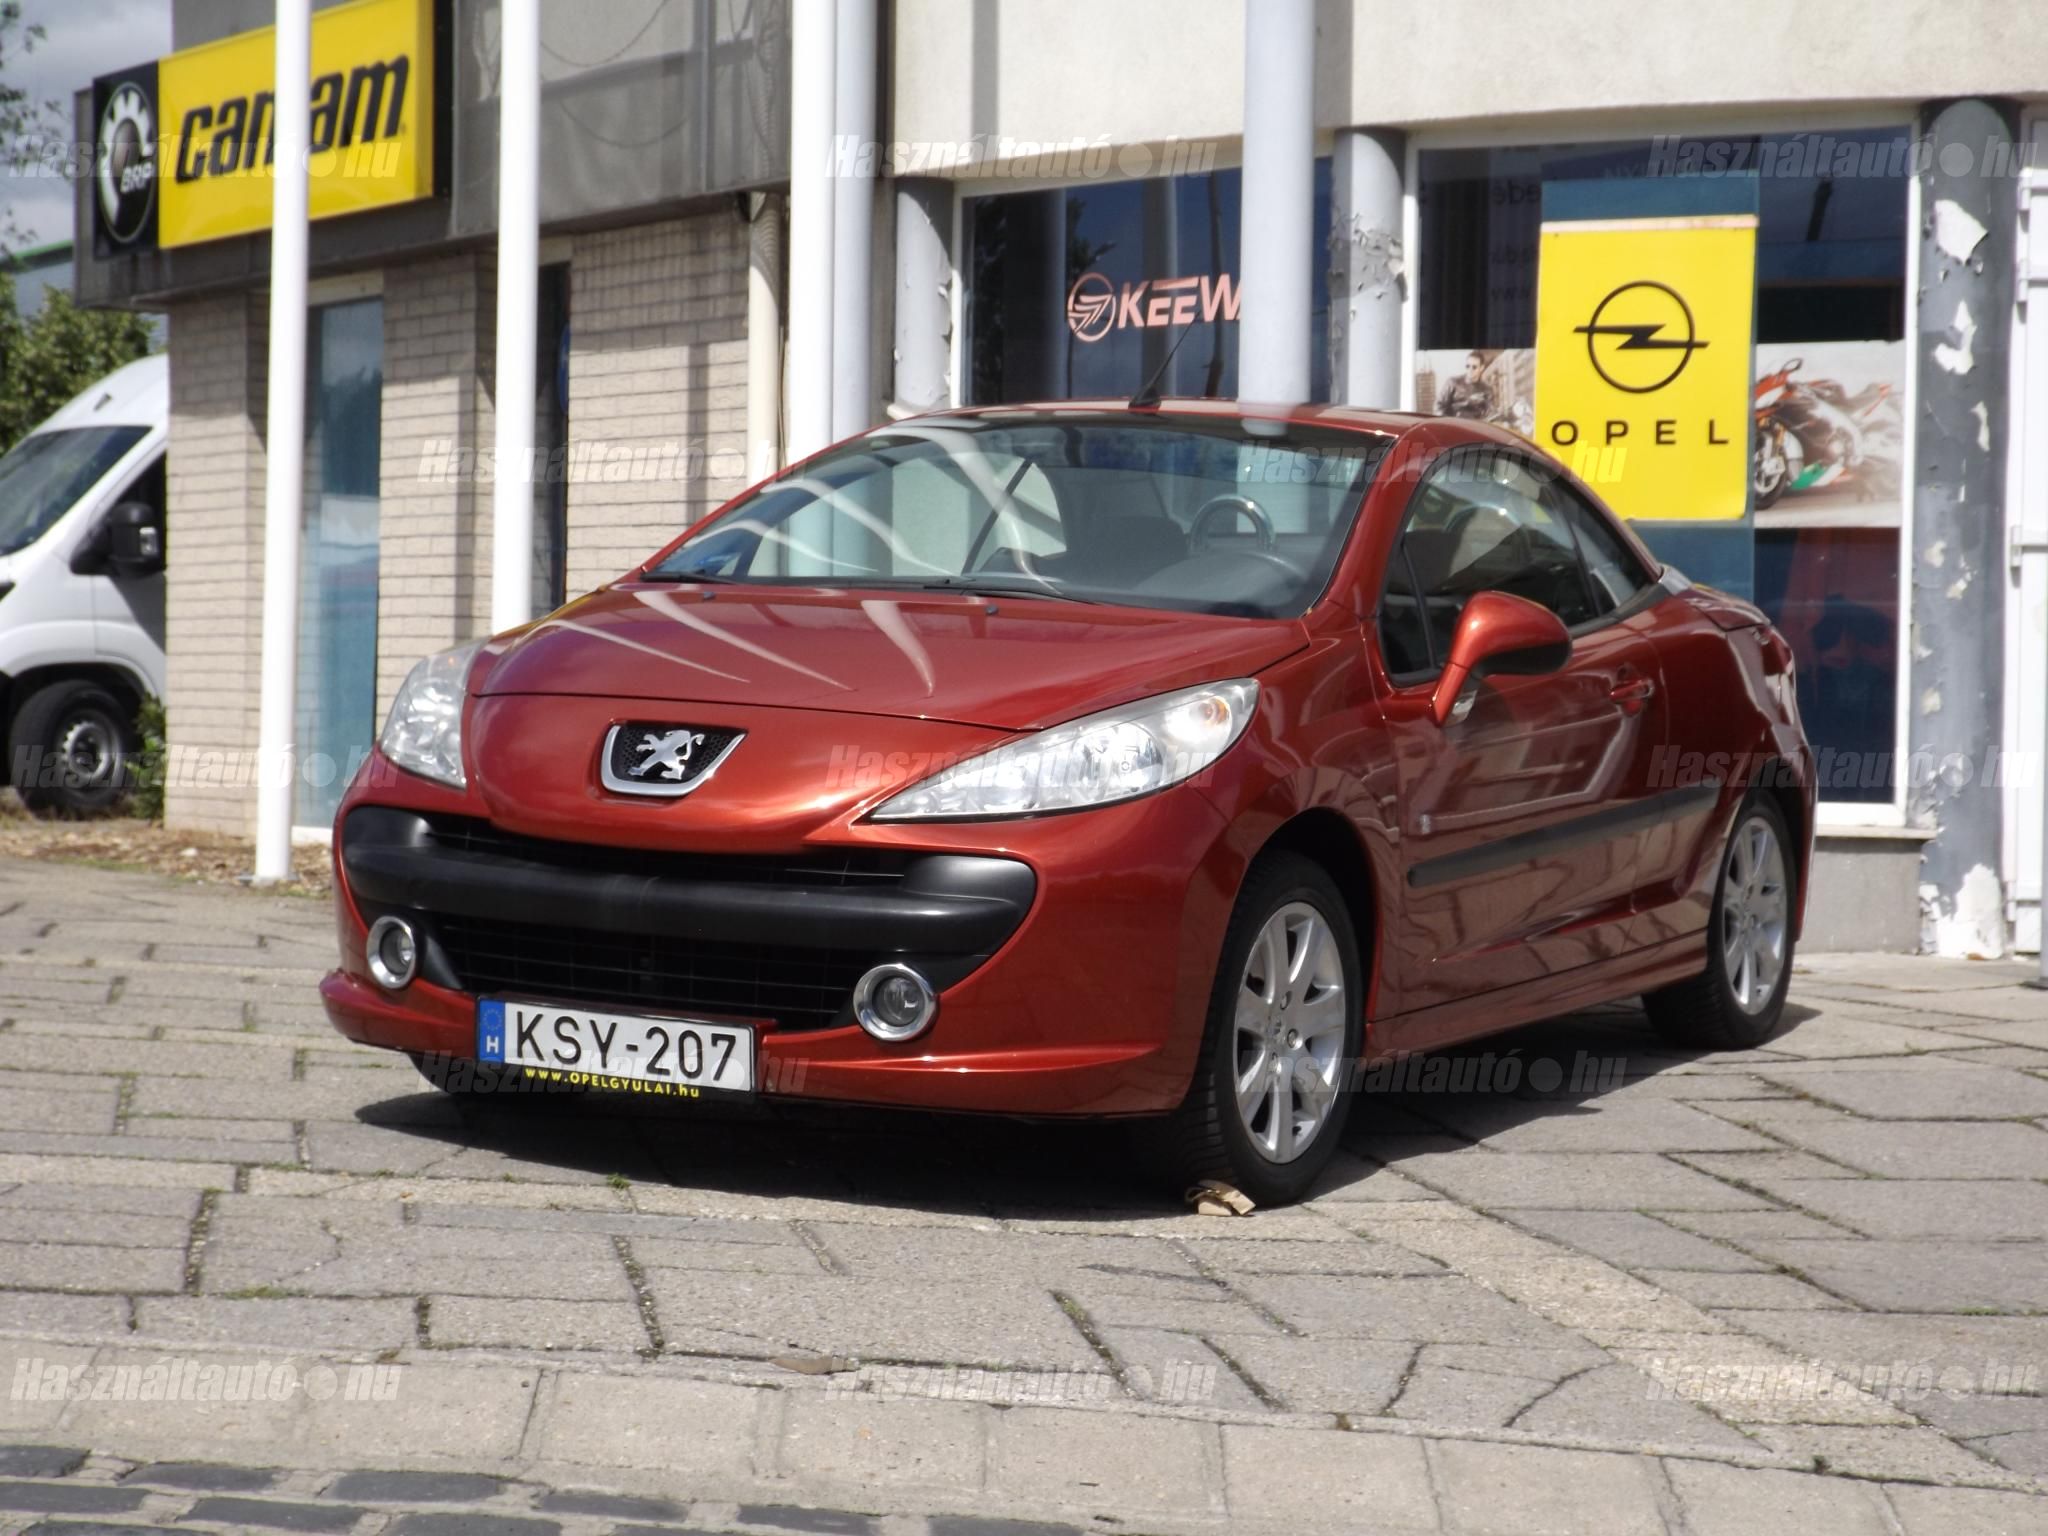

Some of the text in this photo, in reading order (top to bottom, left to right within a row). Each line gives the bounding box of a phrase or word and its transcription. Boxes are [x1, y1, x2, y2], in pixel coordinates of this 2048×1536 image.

[120, 161, 156, 193] BRP
[1117, 273, 1241, 329] KEEW
[1551, 419, 1729, 446] OPEL
[486, 1035, 500, 1054] H
[516, 1010, 737, 1082] KSY-207
[524, 1066, 700, 1099] www.OPELGYULAI.hu
